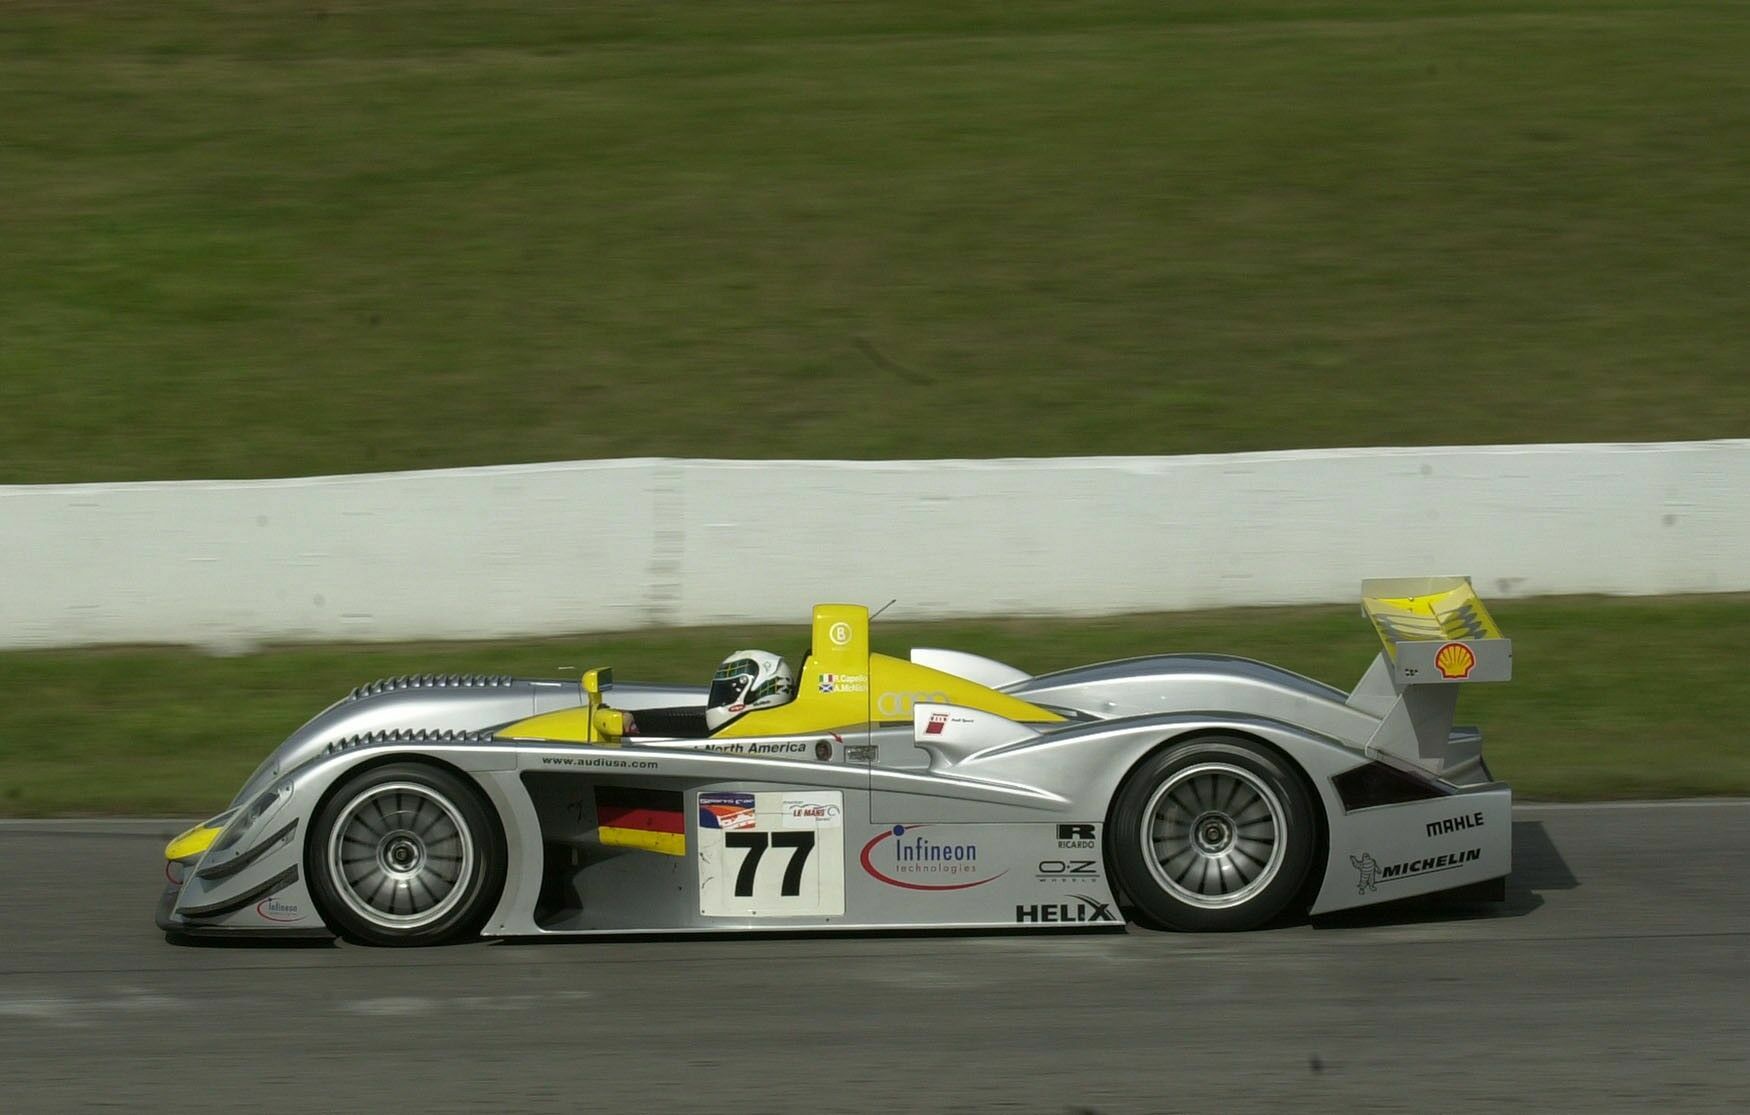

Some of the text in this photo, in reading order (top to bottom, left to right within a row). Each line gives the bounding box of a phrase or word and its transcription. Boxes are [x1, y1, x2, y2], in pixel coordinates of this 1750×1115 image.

[750, 741, 806, 754] America
[542, 756, 658, 769] www.audiusa.com
[793, 808, 802, 817] LE
[1426, 812, 1484, 837] MAHLE
[896, 837, 976, 861] Infineon
[725, 831, 815, 897] 77
[896, 863, 976, 874] technologies
[1382, 848, 1481, 878] MICHELIN
[1016, 899, 1118, 923] HELIX
